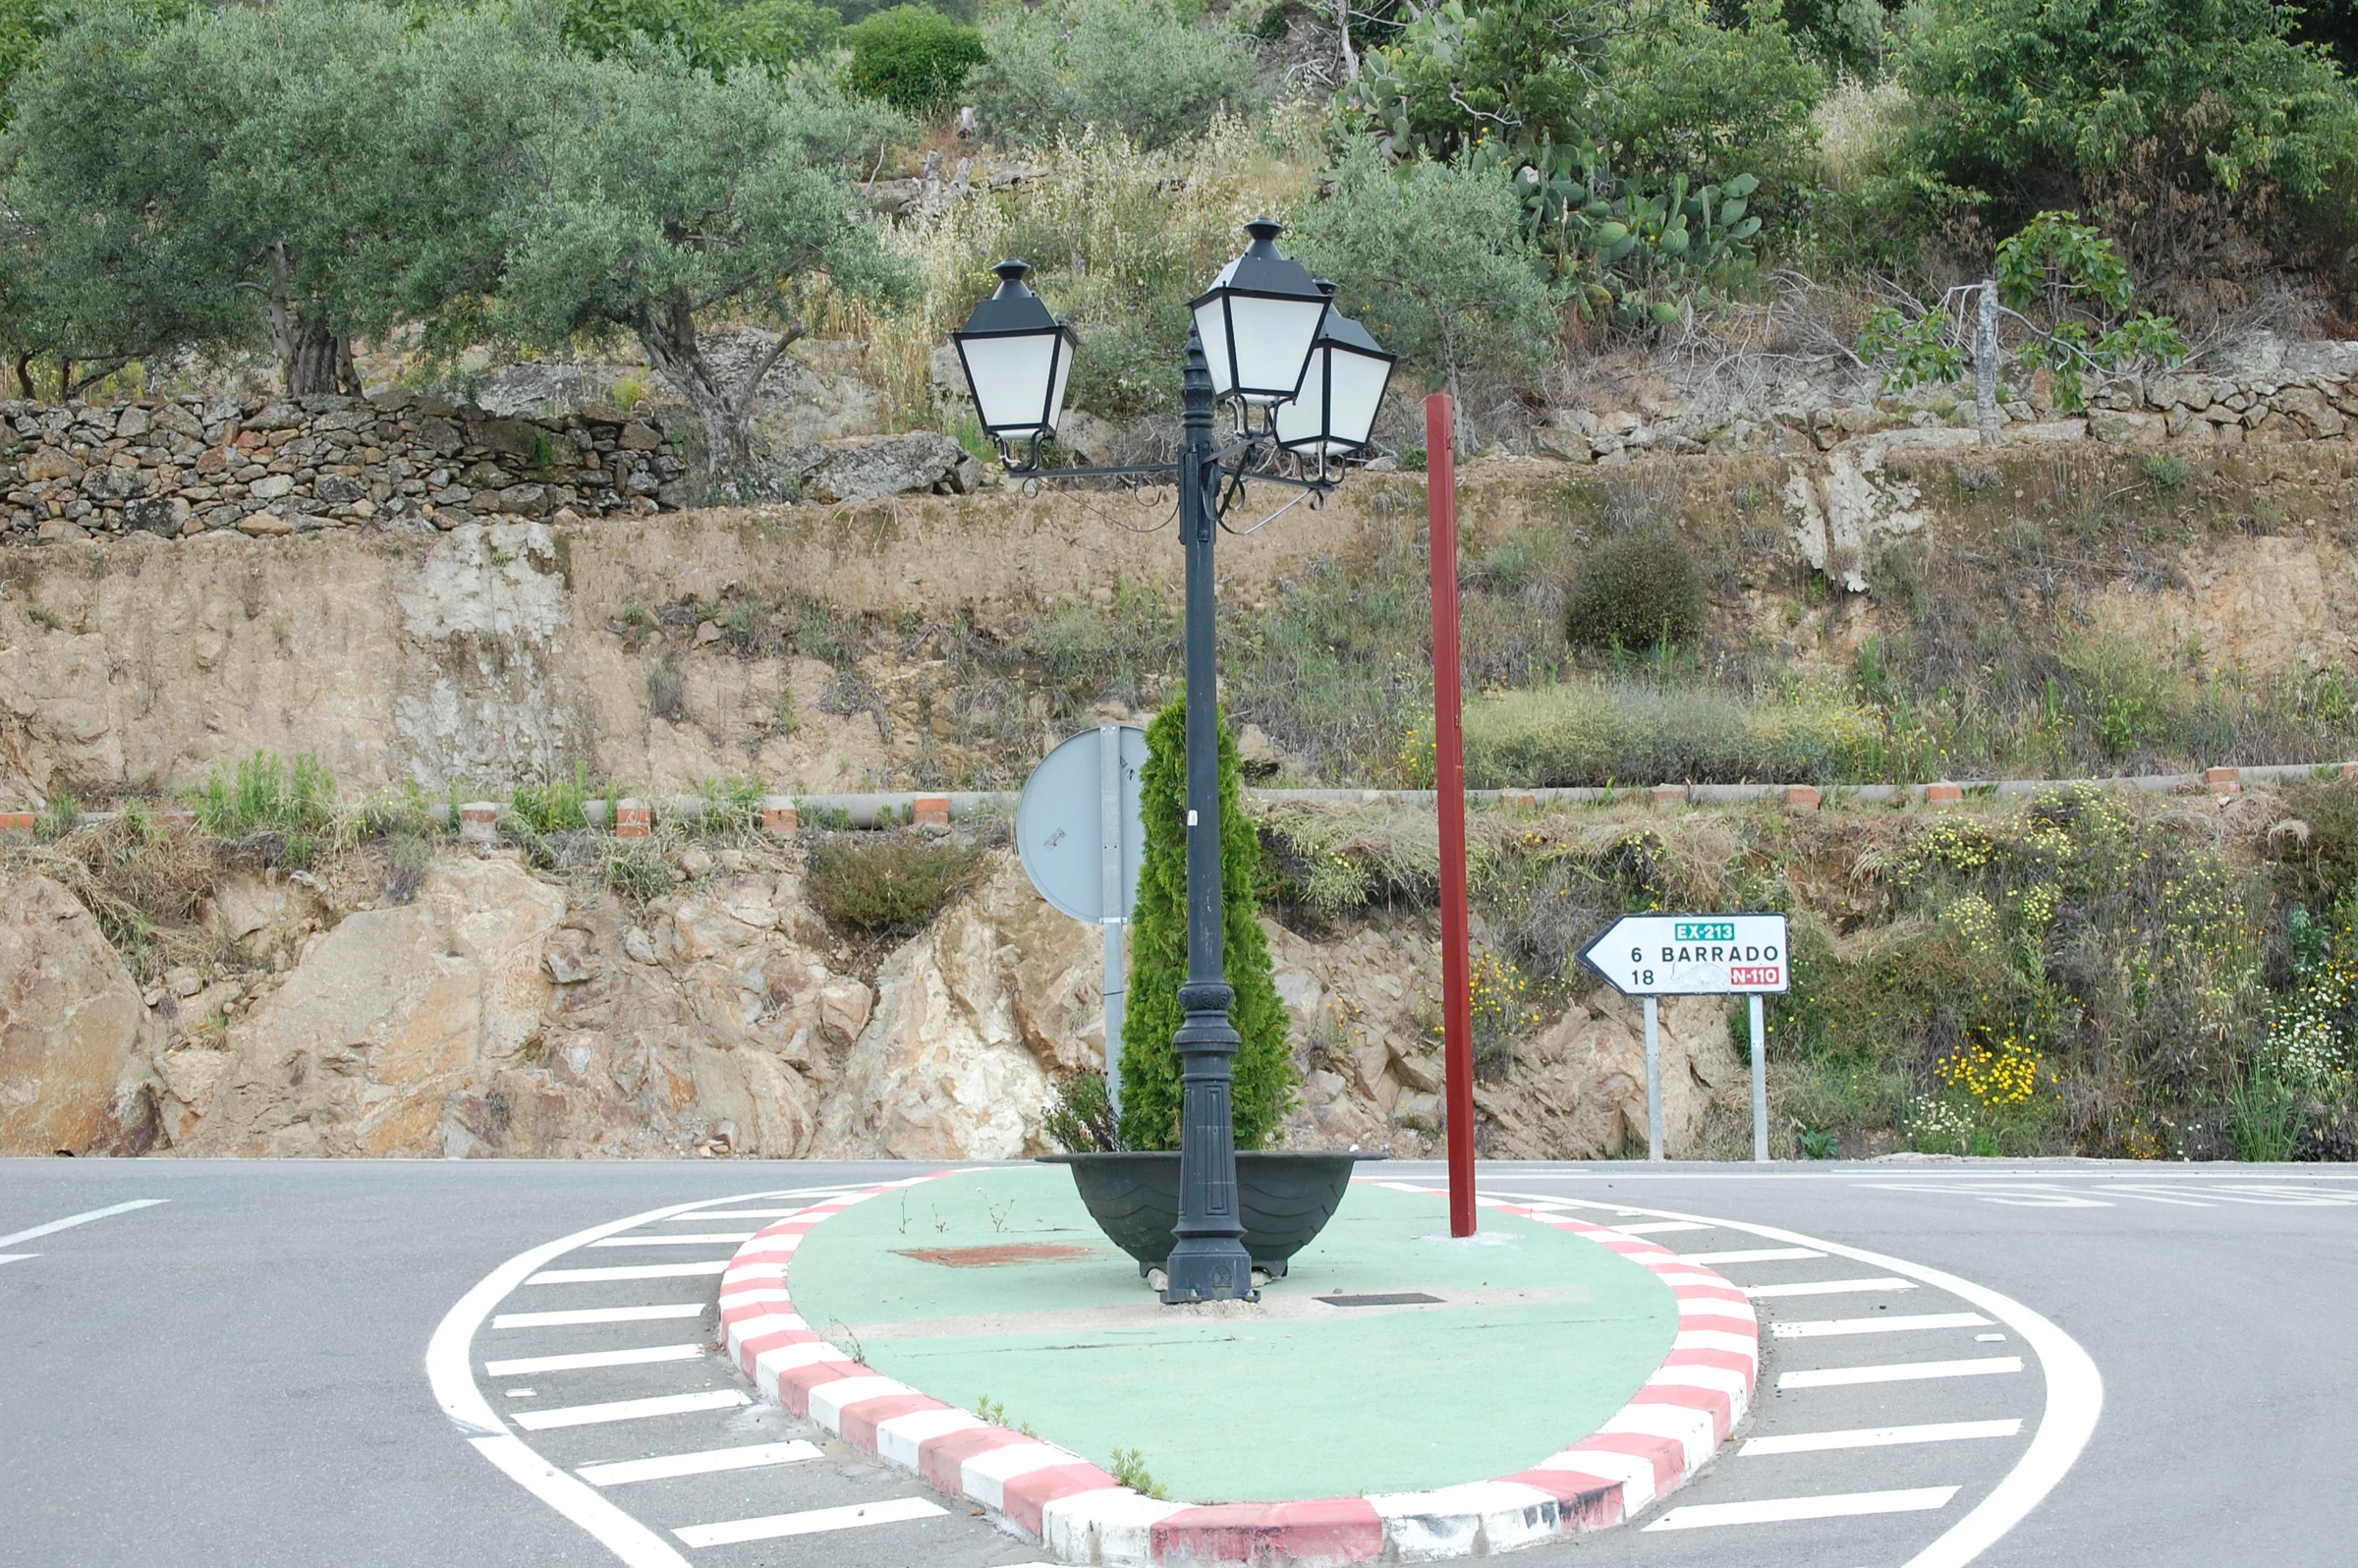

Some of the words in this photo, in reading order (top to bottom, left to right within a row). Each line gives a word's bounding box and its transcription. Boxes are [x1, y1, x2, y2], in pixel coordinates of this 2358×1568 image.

[1676, 924, 1732, 939] EX-213
[1631, 947, 1643, 963] 6
[1661, 945, 1778, 962] BARRADO
[1632, 970, 1655, 985] 18
[1732, 969, 1777, 983] N-110
